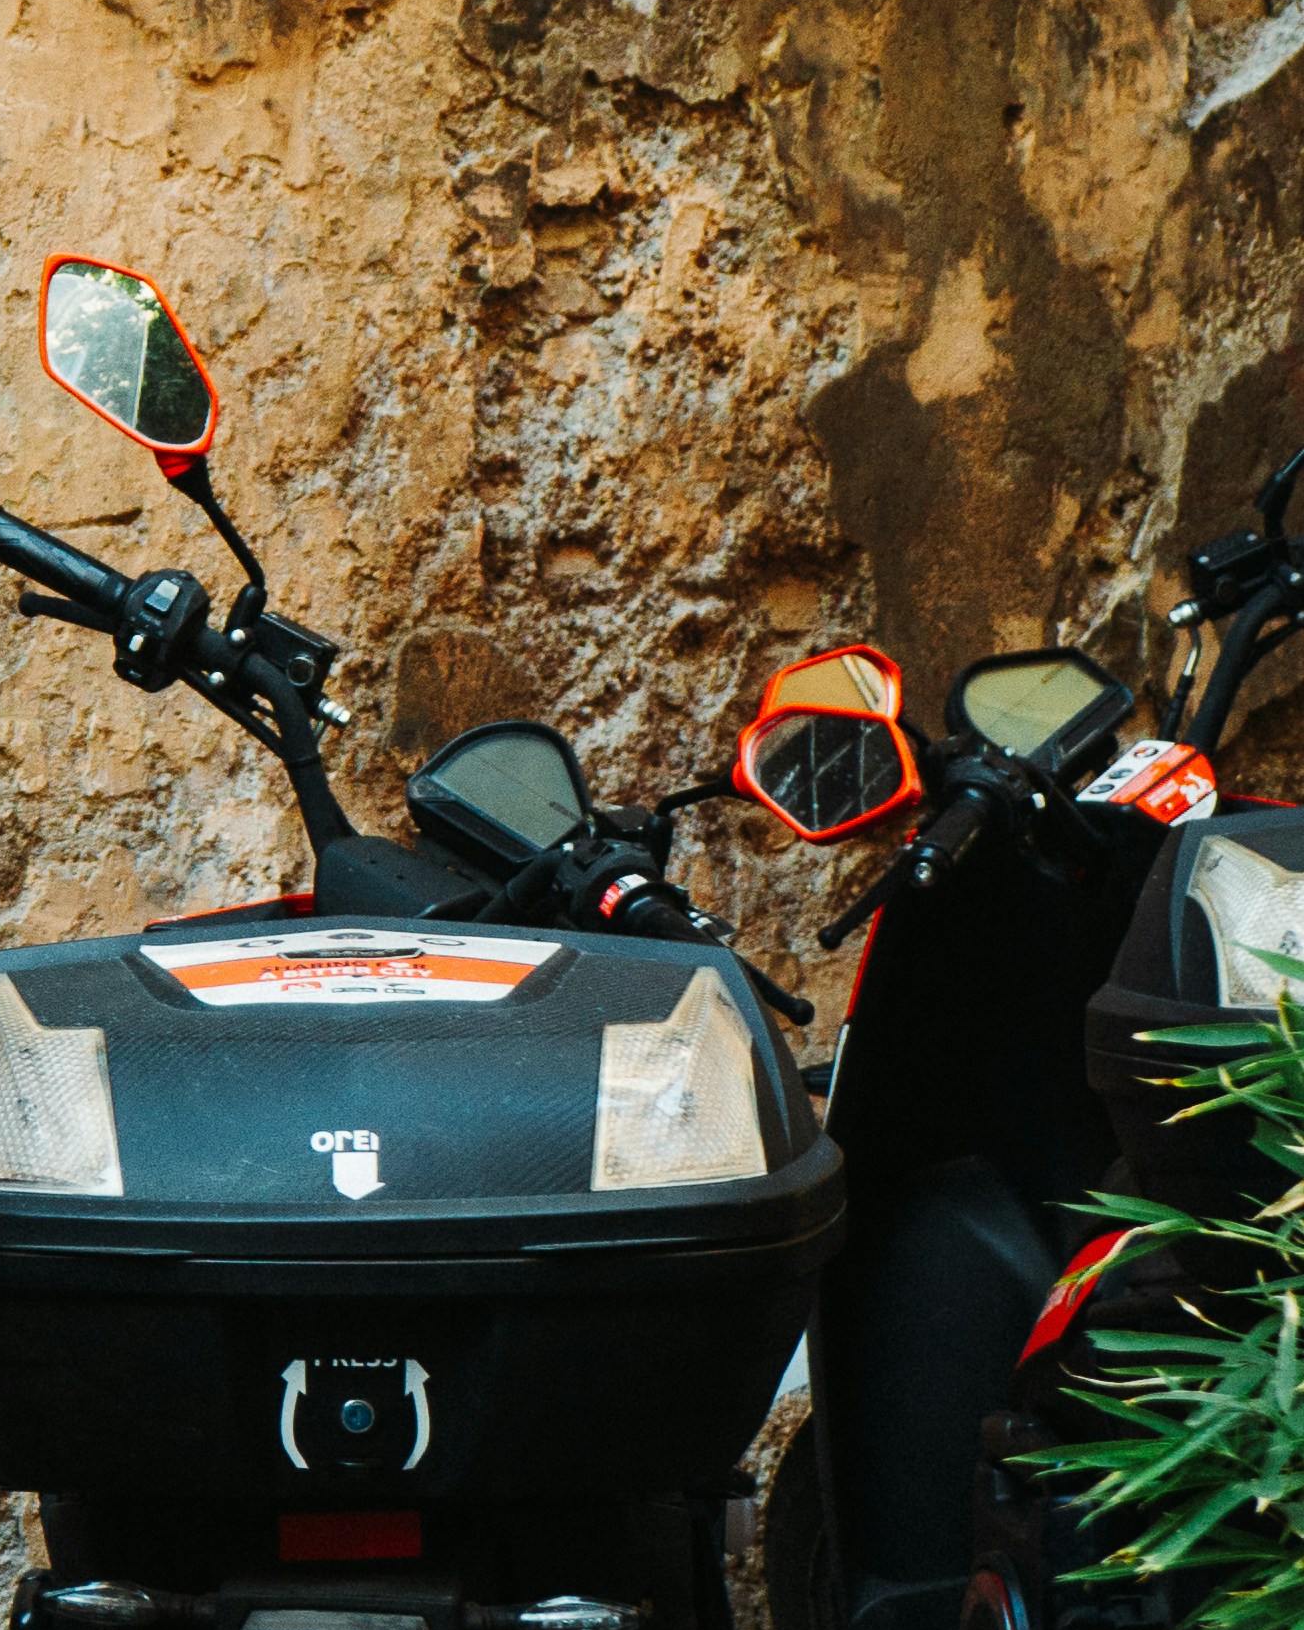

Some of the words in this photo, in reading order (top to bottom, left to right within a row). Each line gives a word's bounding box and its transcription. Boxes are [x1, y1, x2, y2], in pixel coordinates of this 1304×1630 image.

[259, 971, 277, 981] A
[283, 966, 372, 979] BETTER
[379, 967, 433, 978] CITY
